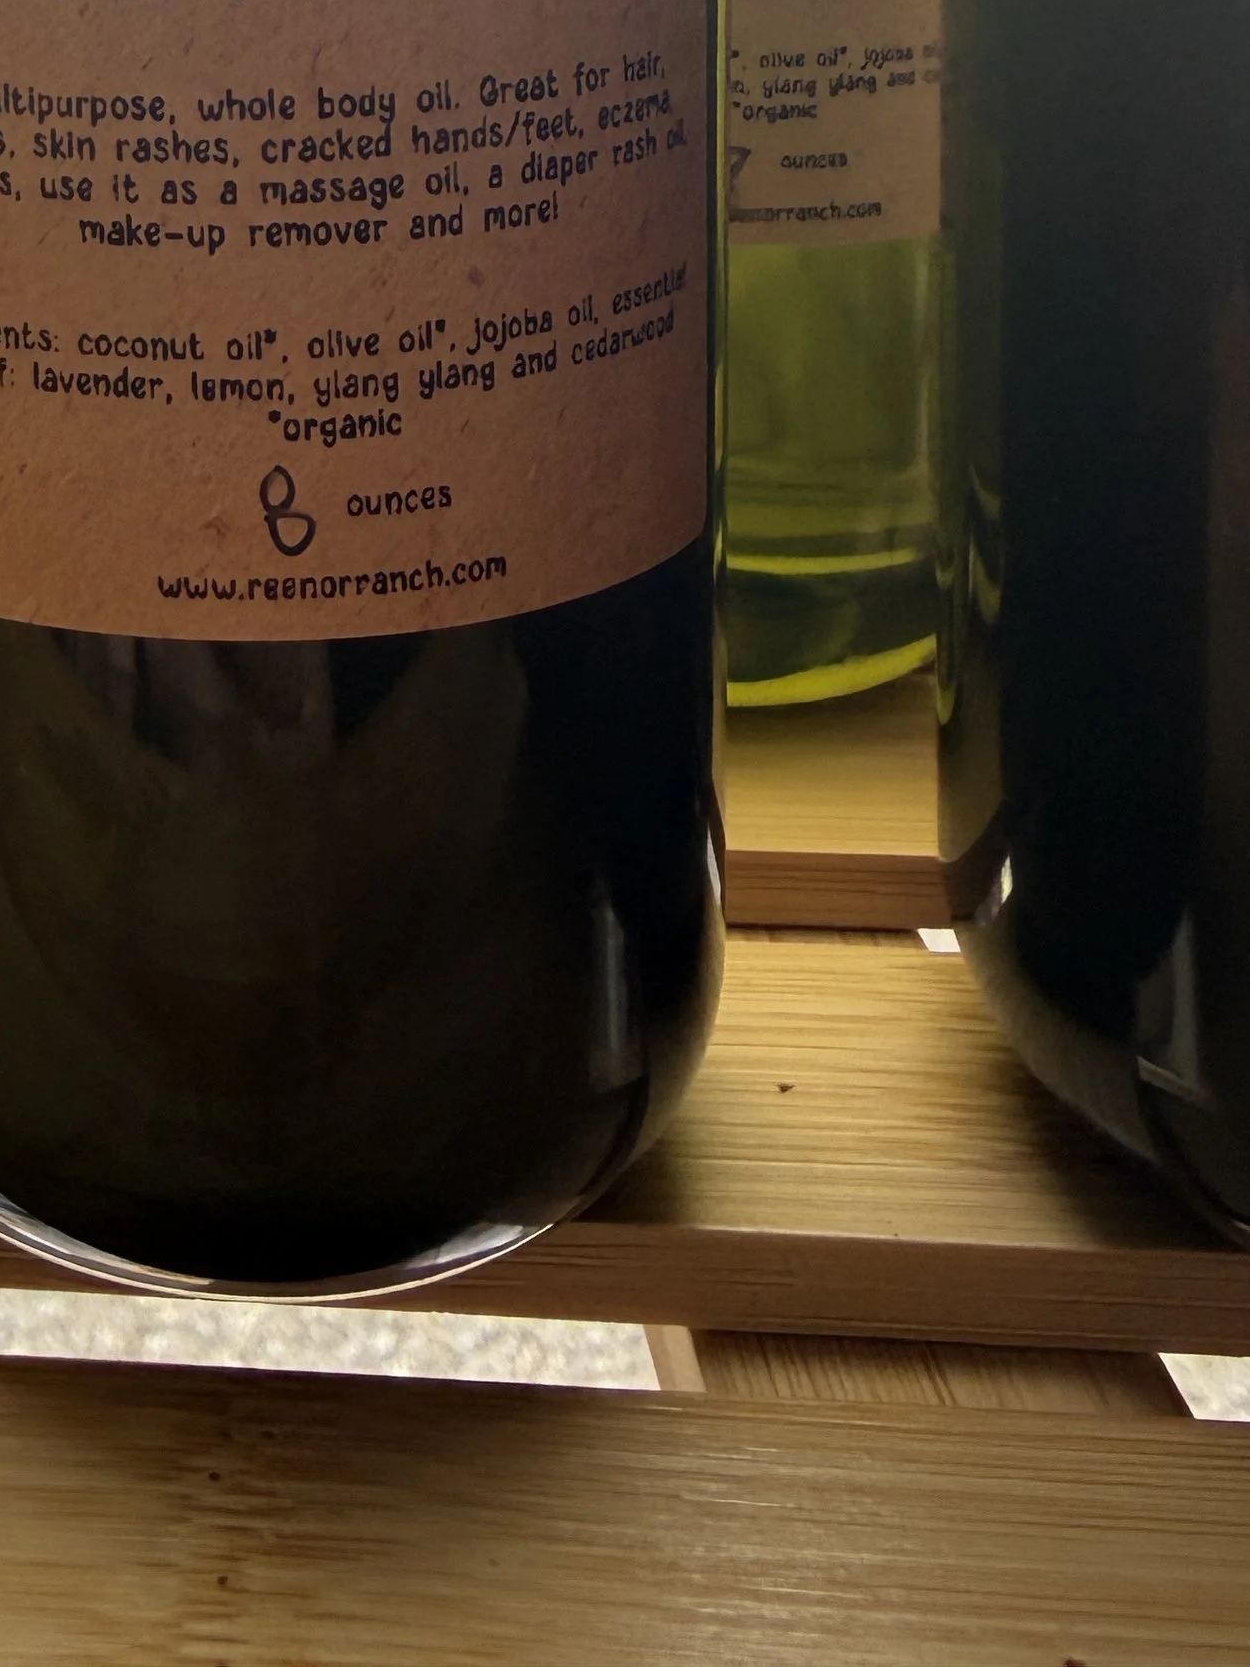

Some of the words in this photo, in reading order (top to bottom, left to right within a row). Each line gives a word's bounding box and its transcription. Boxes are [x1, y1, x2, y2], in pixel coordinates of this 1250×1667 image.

[197, 87, 297, 122] whole
[317, 85, 396, 124] body
[416, 79, 461, 114] oil.
[479, 74, 560, 107] Great
[573, 61, 611, 97] for
[622, 50, 666, 82] hair,
[33, 127, 97, 162] skin
[115, 128, 240, 169] rashes,
[260, 121, 392, 163] cracked
[410, 107, 585, 156] hands/feet,
[39, 175, 94, 203] use
[111, 173, 140, 205] it
[160, 179, 198, 206] as
[219, 179, 239, 206] a
[259, 172, 406, 211] massage
[424, 160, 469, 197] oil,
[488, 163, 503, 189] a
[520, 150, 599, 187] diaper
[612, 126, 658, 167] rash
[78, 213, 226, 257] make-up
[247, 217, 389, 248] remover
[408, 202, 464, 240] and
[483, 190, 560, 233] more!
[32, 360, 174, 406] lavender,
[190, 370, 296, 406] lemon,
[312, 369, 400, 408] ylang
[418, 359, 496, 401] ylang
[510, 338, 558, 379] and
[570, 299, 676, 366] cedarwood
[77, 331, 205, 362] coconut
[306, 328, 381, 359] olive
[465, 307, 554, 356] jojoba
[567, 293, 600, 327] oil,
[258, 464, 317, 557] 8
[345, 484, 454, 519] ounces
[155, 554, 509, 605] www.reenorranch.com
